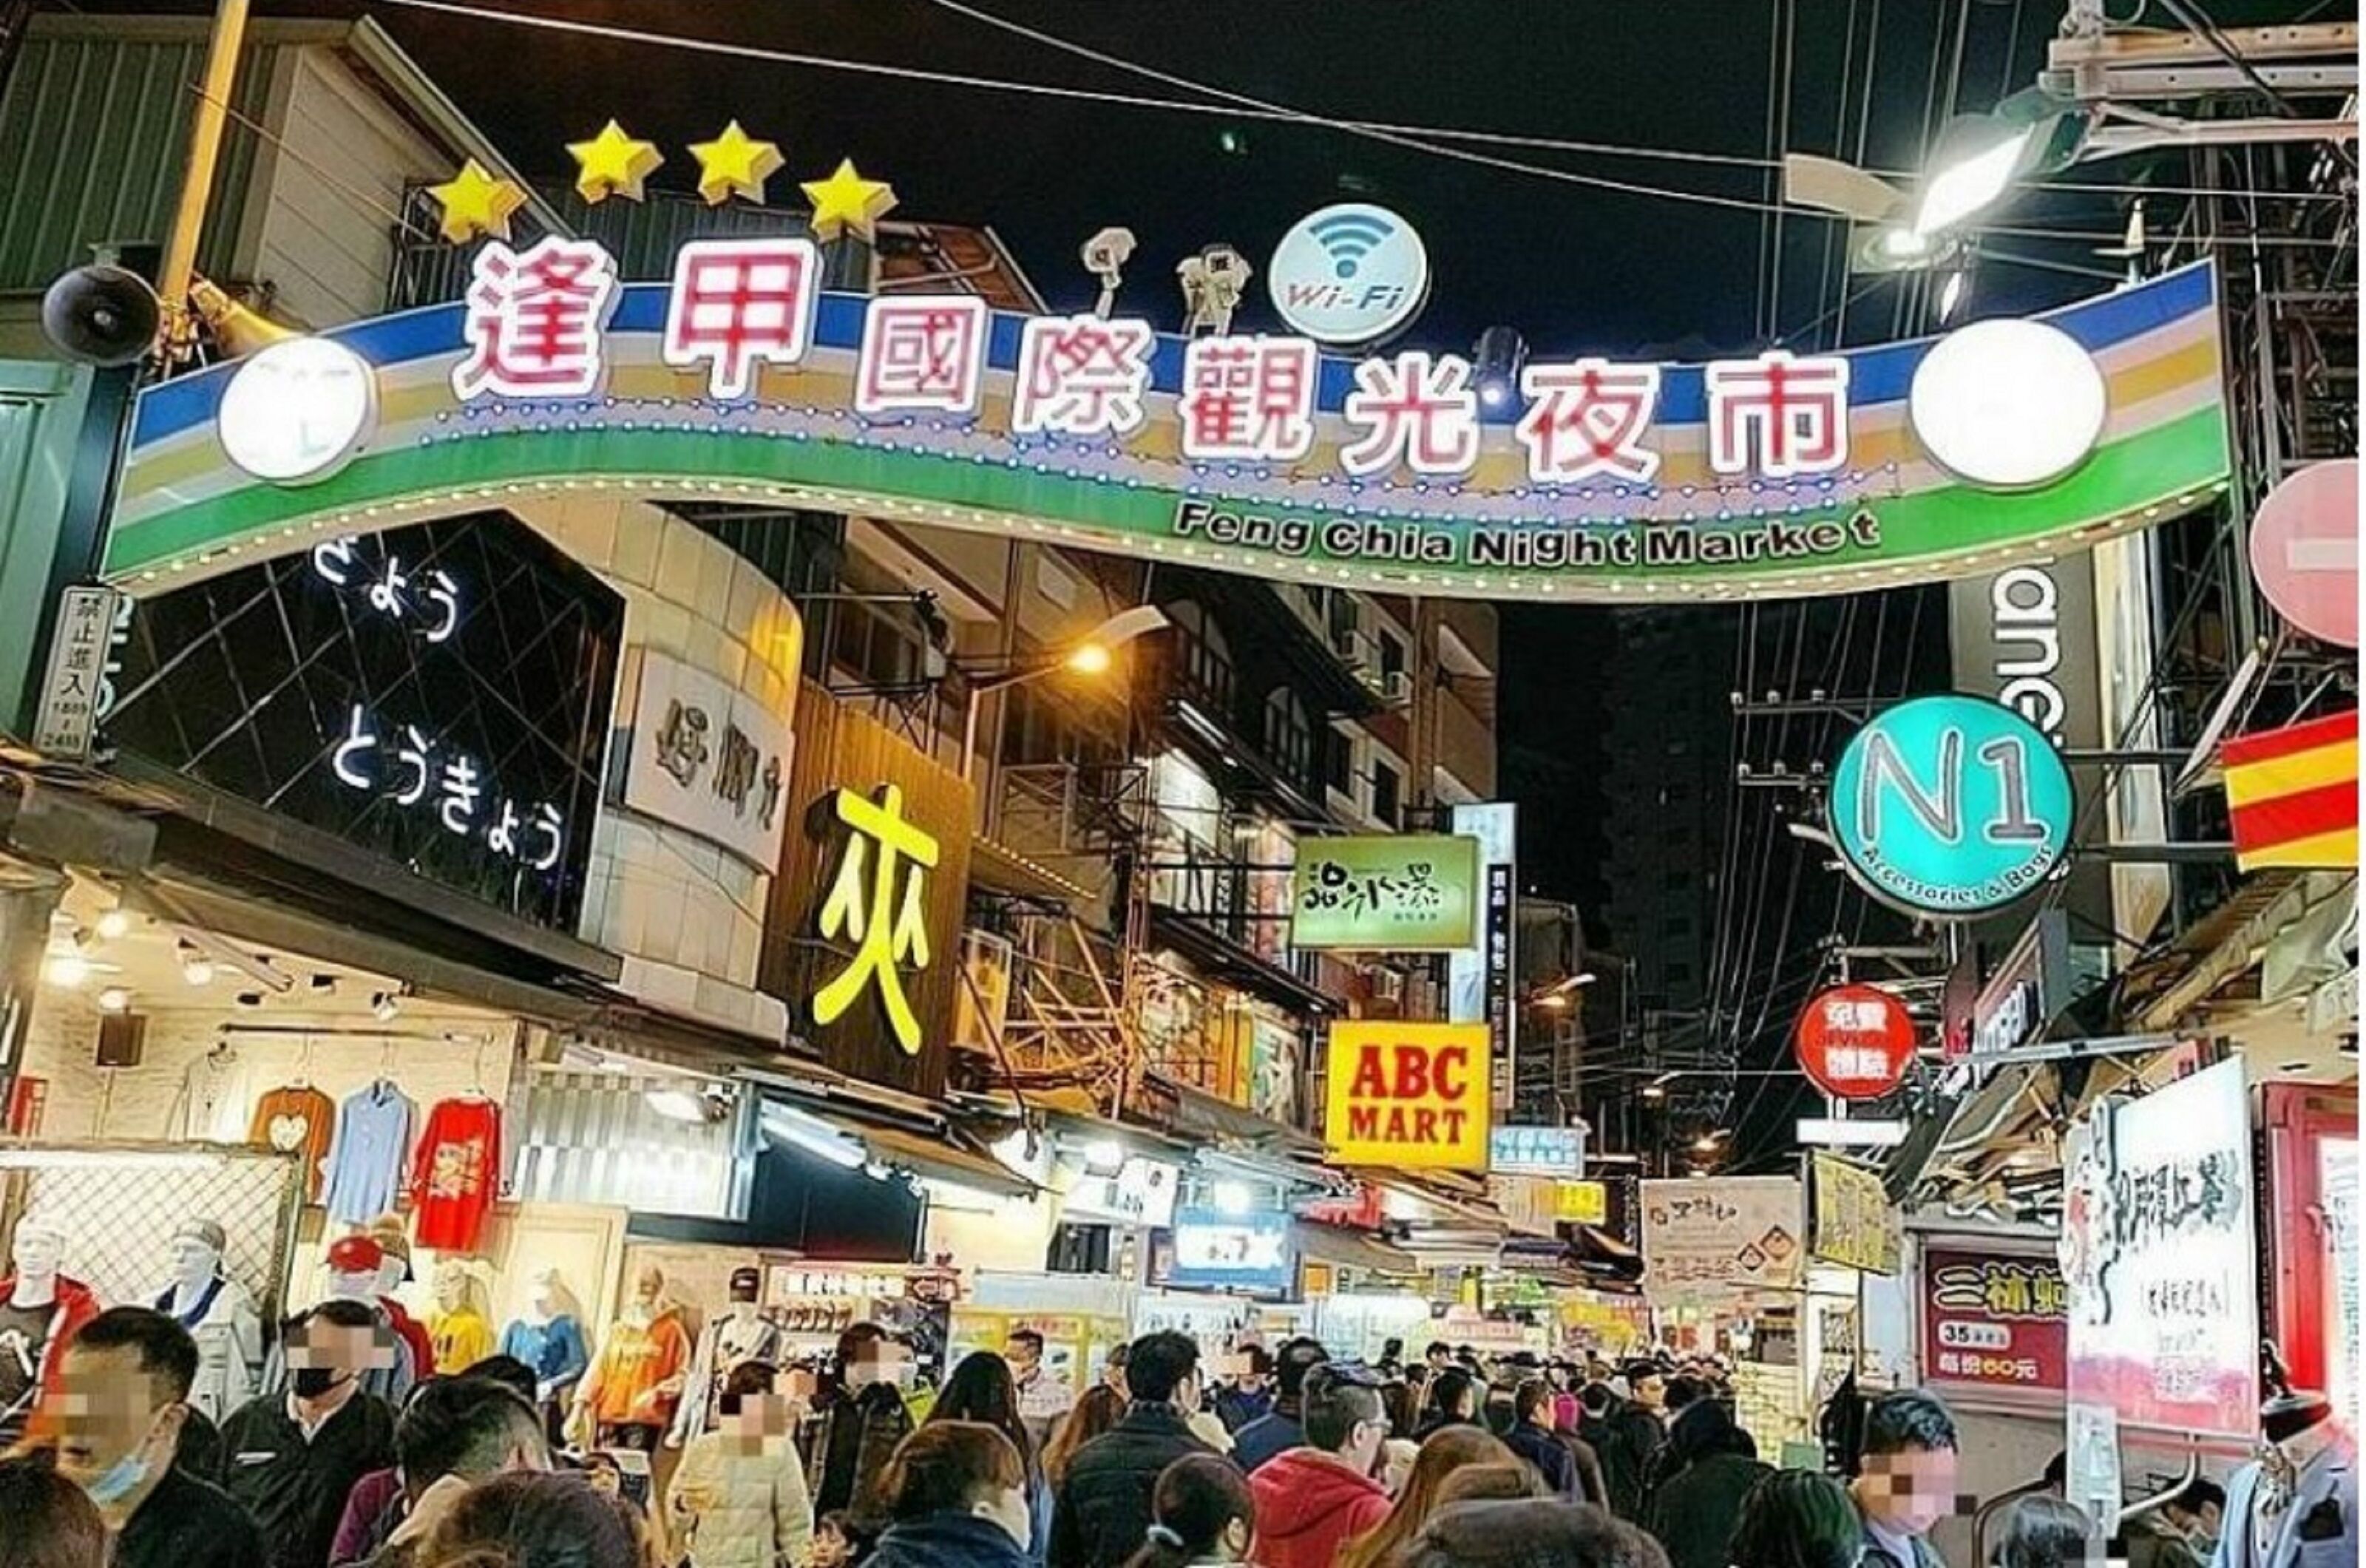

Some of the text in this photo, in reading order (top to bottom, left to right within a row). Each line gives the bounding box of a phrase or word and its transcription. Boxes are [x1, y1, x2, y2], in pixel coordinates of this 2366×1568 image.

[452, 235, 1850, 478] 逢甲國際觀光夜市
[1287, 284, 1405, 310] Wi-Fi
[1177, 499, 1881, 567] Feng Chia Night Market
[1993, 556, 2064, 748] ane
[332, 704, 562, 870] とうきょう
[1857, 726, 2053, 846] N1
[814, 784, 939, 1056] 夾
[1347, 1104, 1468, 1146] MART
[1348, 1045, 1470, 1101] ABC
